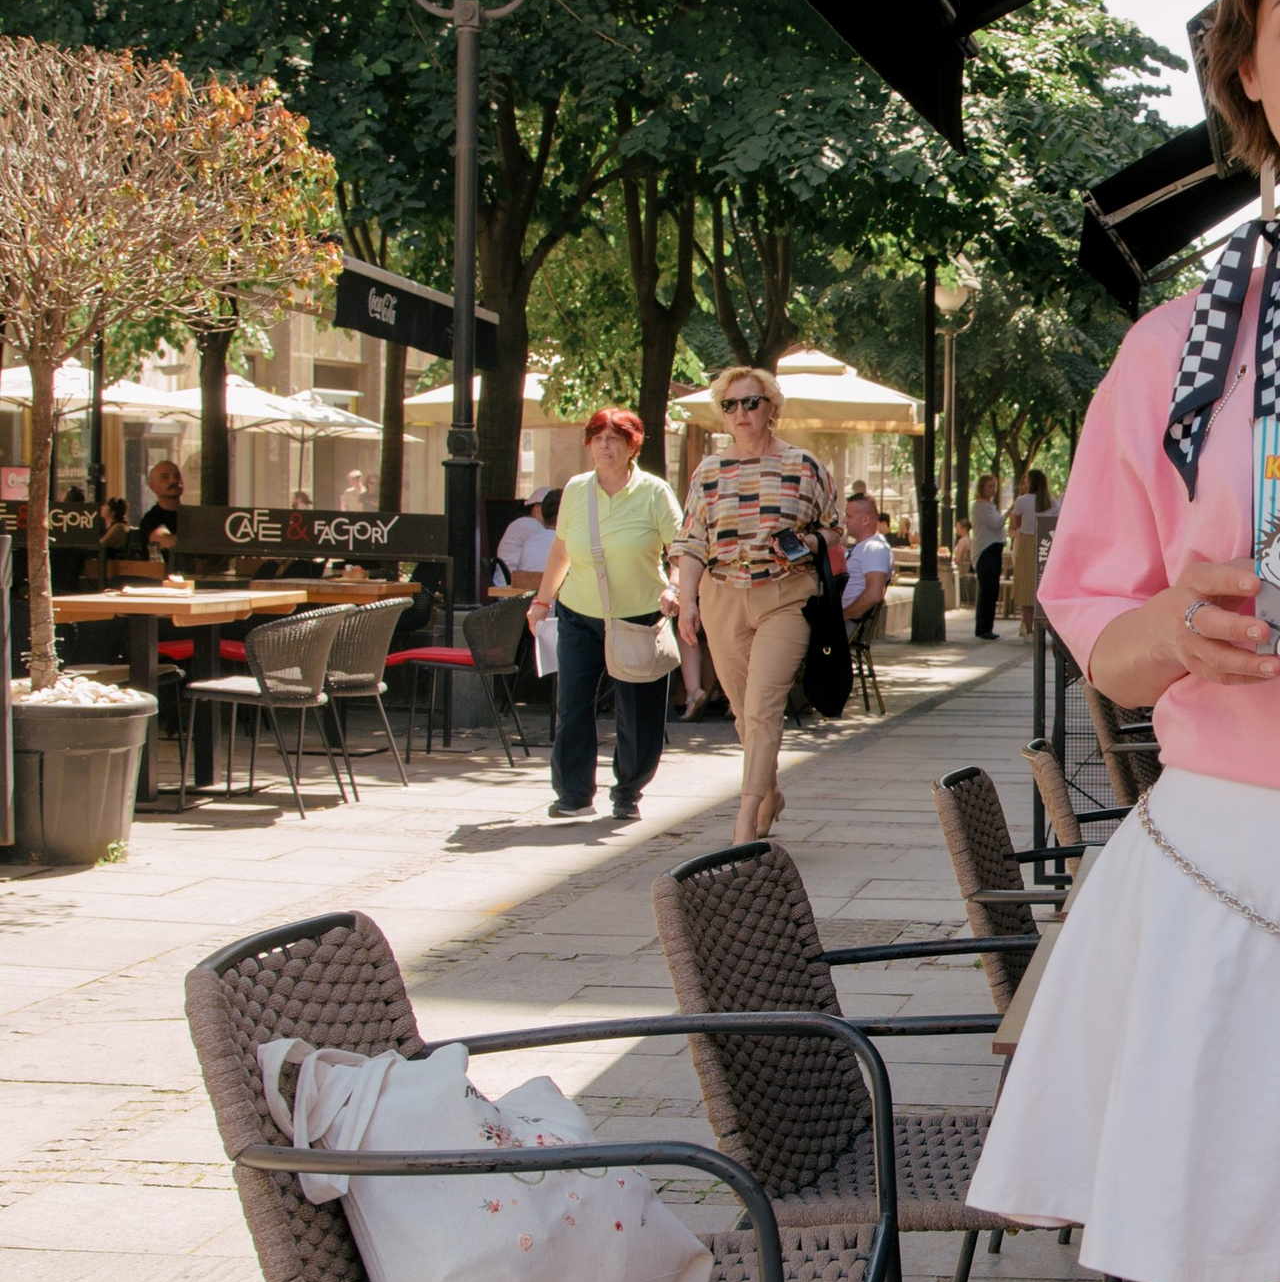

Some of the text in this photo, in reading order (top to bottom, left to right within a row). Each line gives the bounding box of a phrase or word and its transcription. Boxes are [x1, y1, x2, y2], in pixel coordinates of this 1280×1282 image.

[49, 509, 98, 533] CTORY
[225, 509, 400, 551] CAFE & FACTORY
[1038, 538, 1051, 563] THE
